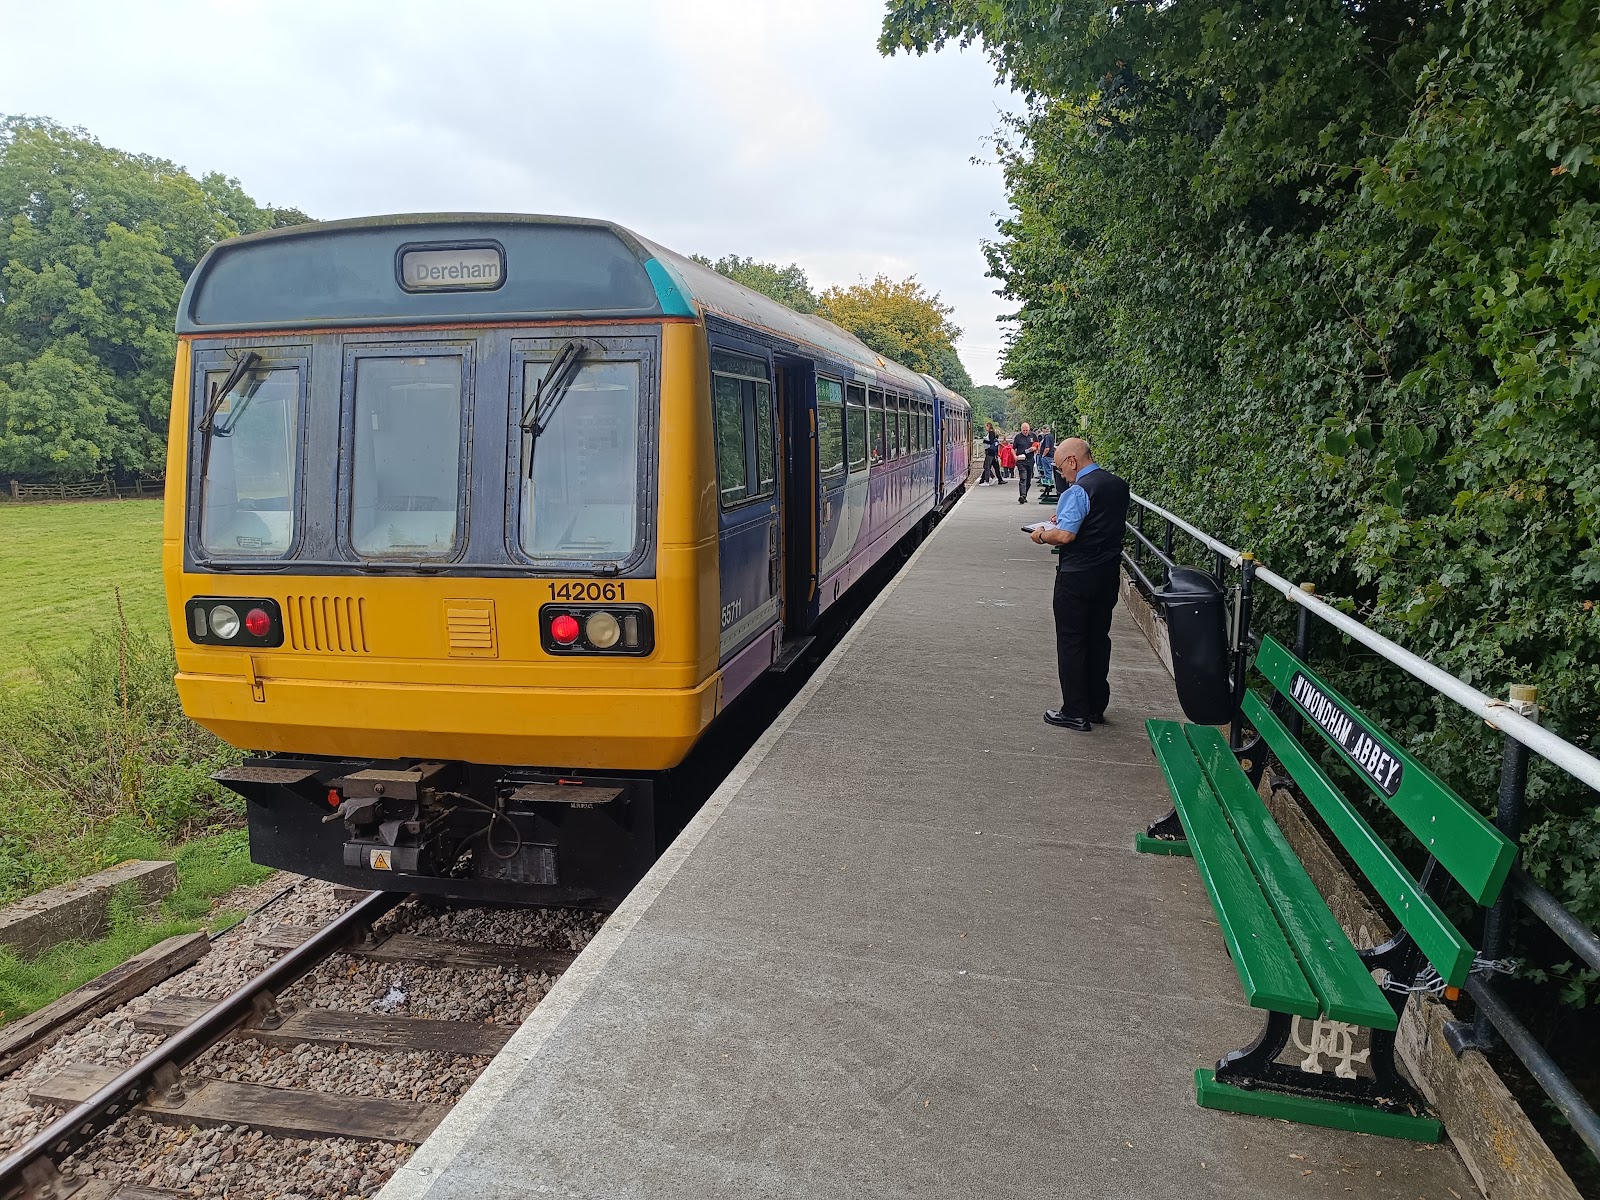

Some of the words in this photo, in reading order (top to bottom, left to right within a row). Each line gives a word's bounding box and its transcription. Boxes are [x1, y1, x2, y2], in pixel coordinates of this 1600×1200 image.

[416, 262, 498, 280] Dereham
[548, 582, 625, 600] 142061
[721, 598, 742, 627] 55711
[1293, 674, 1353, 746] WYMONDHAM
[1352, 732, 1400, 788] ABBEY
